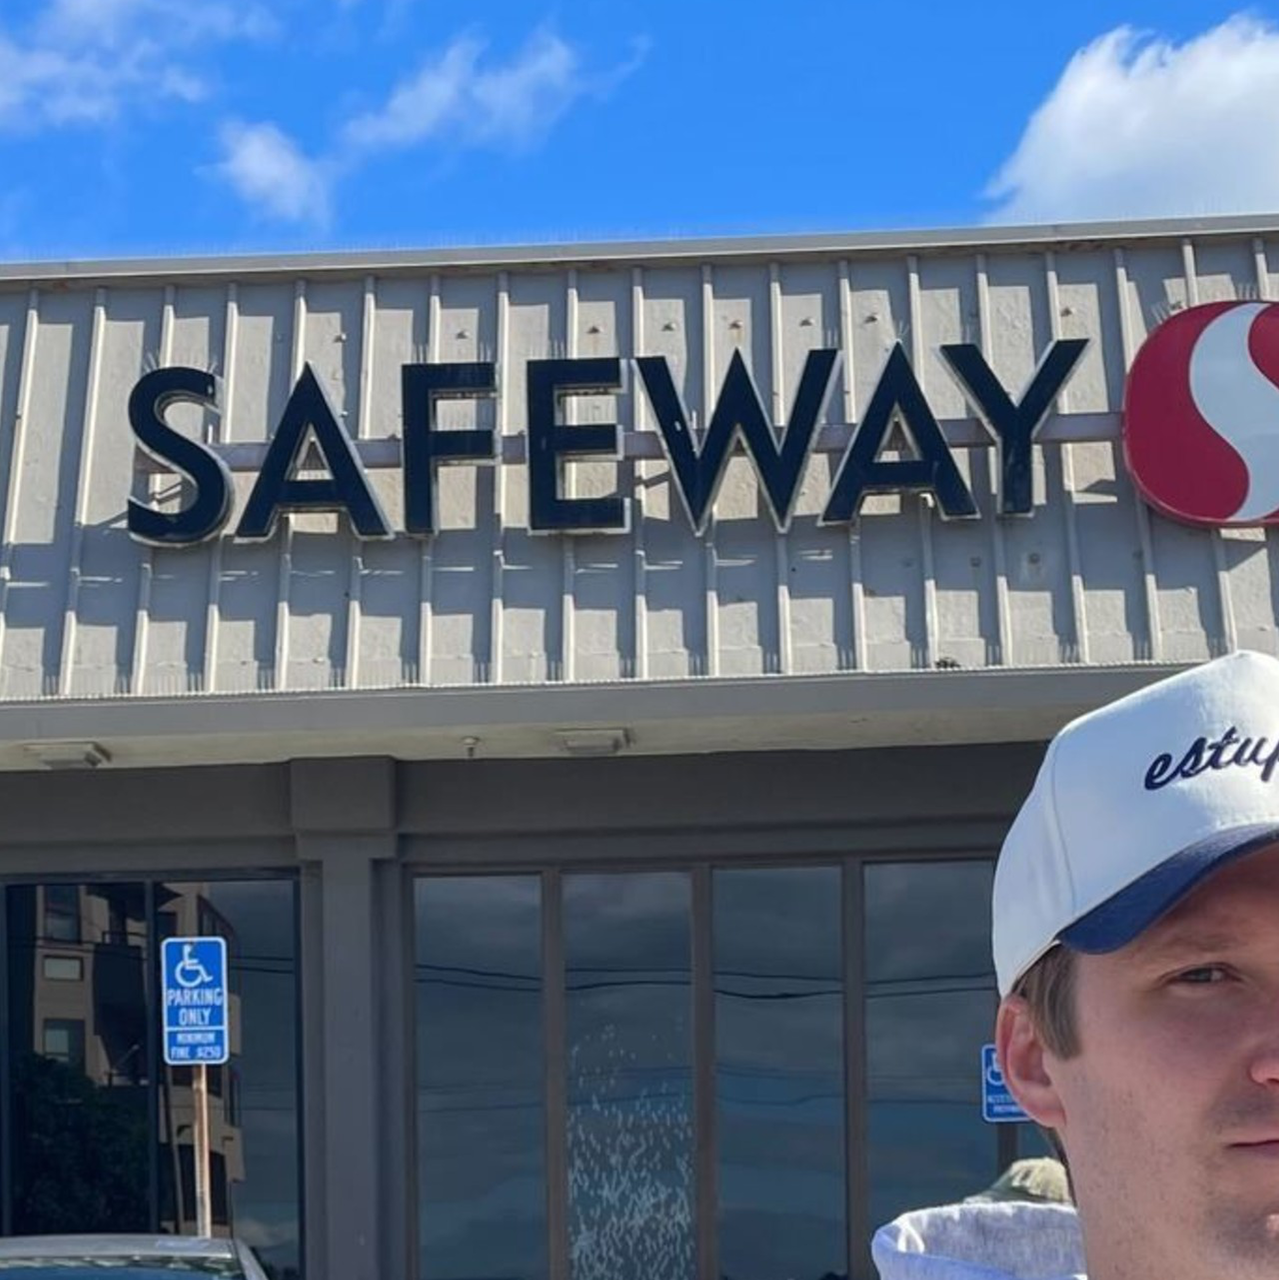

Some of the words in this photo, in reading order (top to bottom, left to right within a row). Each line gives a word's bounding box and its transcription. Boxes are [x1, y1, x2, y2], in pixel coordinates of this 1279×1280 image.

[127, 338, 1090, 546] SAFEWAY
[166, 987, 223, 1006] PARKING
[179, 1007, 211, 1026] ONLY
